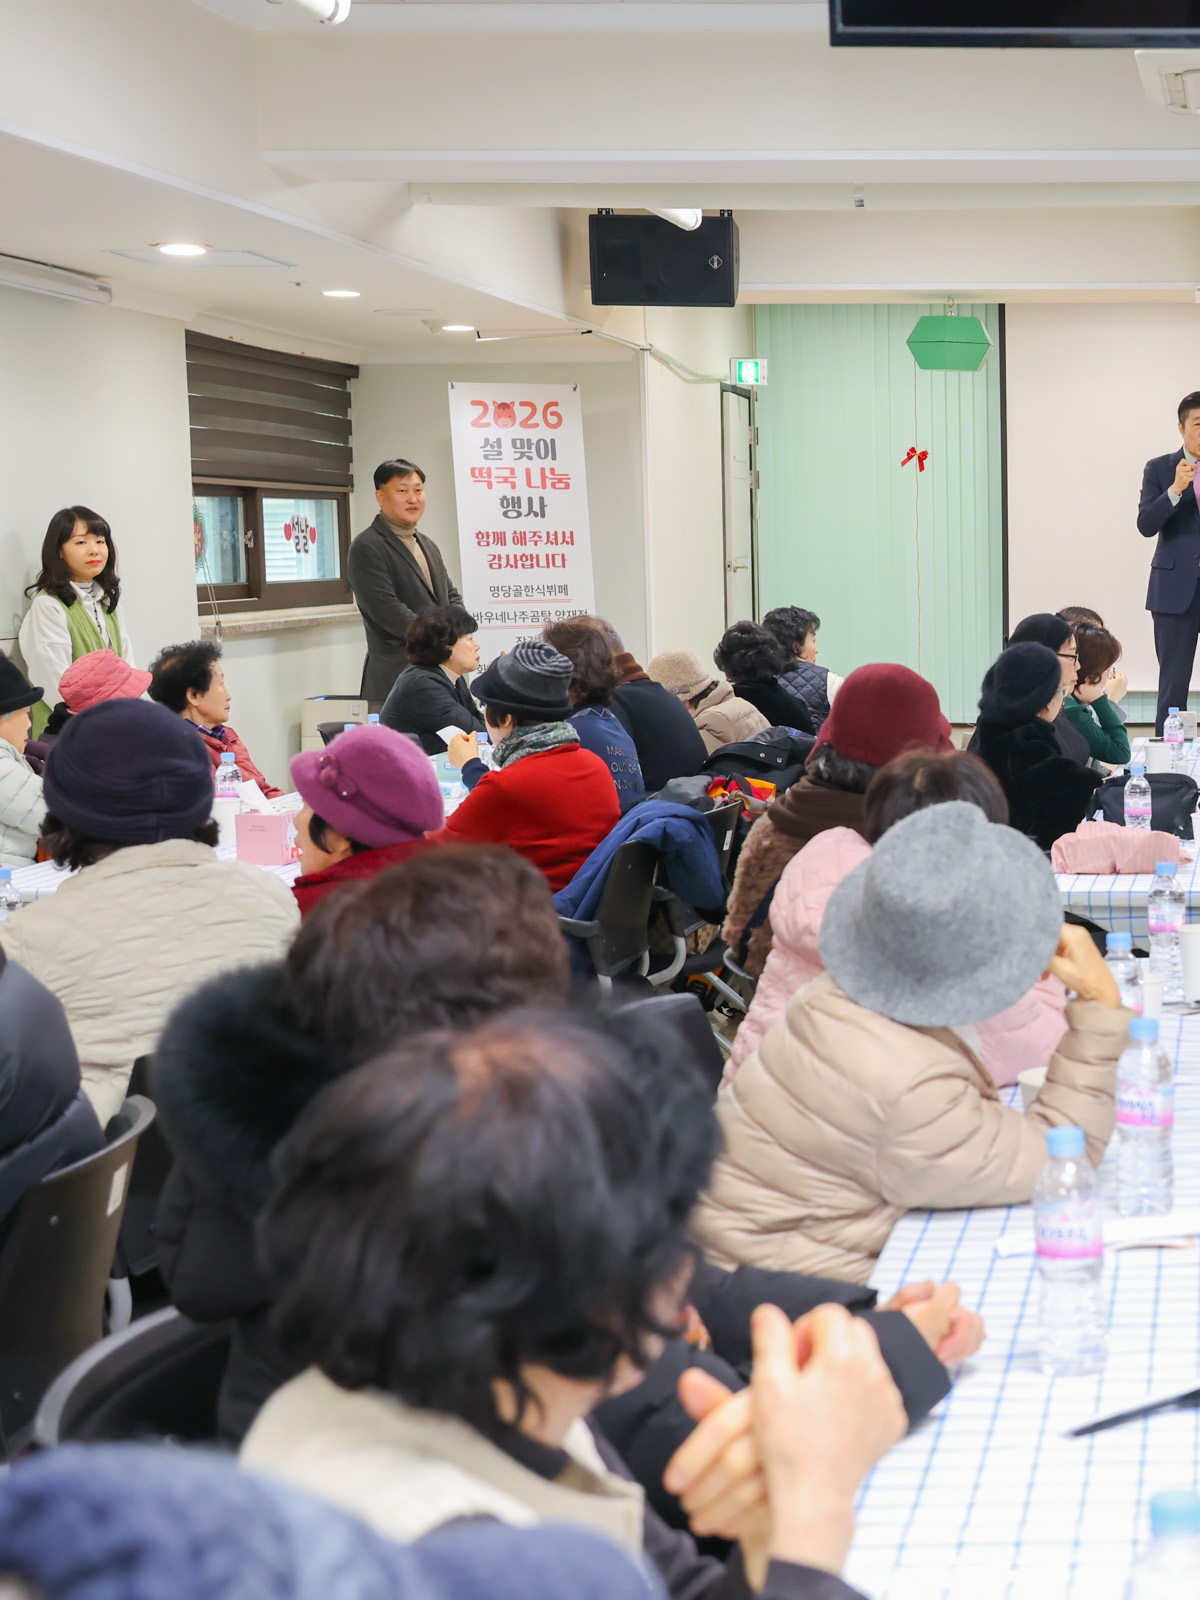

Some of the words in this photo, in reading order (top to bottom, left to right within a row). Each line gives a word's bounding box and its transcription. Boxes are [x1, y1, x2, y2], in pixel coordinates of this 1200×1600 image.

[479, 437, 503, 461] 설
[511, 437, 556, 461] 맞이
[470, 466, 517, 490] 떡국
[525, 466, 571, 490] 나눔
[499, 495, 548, 519] 행사
[292, 516, 309, 553] 설날
[474, 530, 507, 547] 함께
[511, 530, 575, 547] 해주셔서
[486, 553, 567, 571] 감사합니다
[489, 584, 569, 598] 명당골한식뷔페
